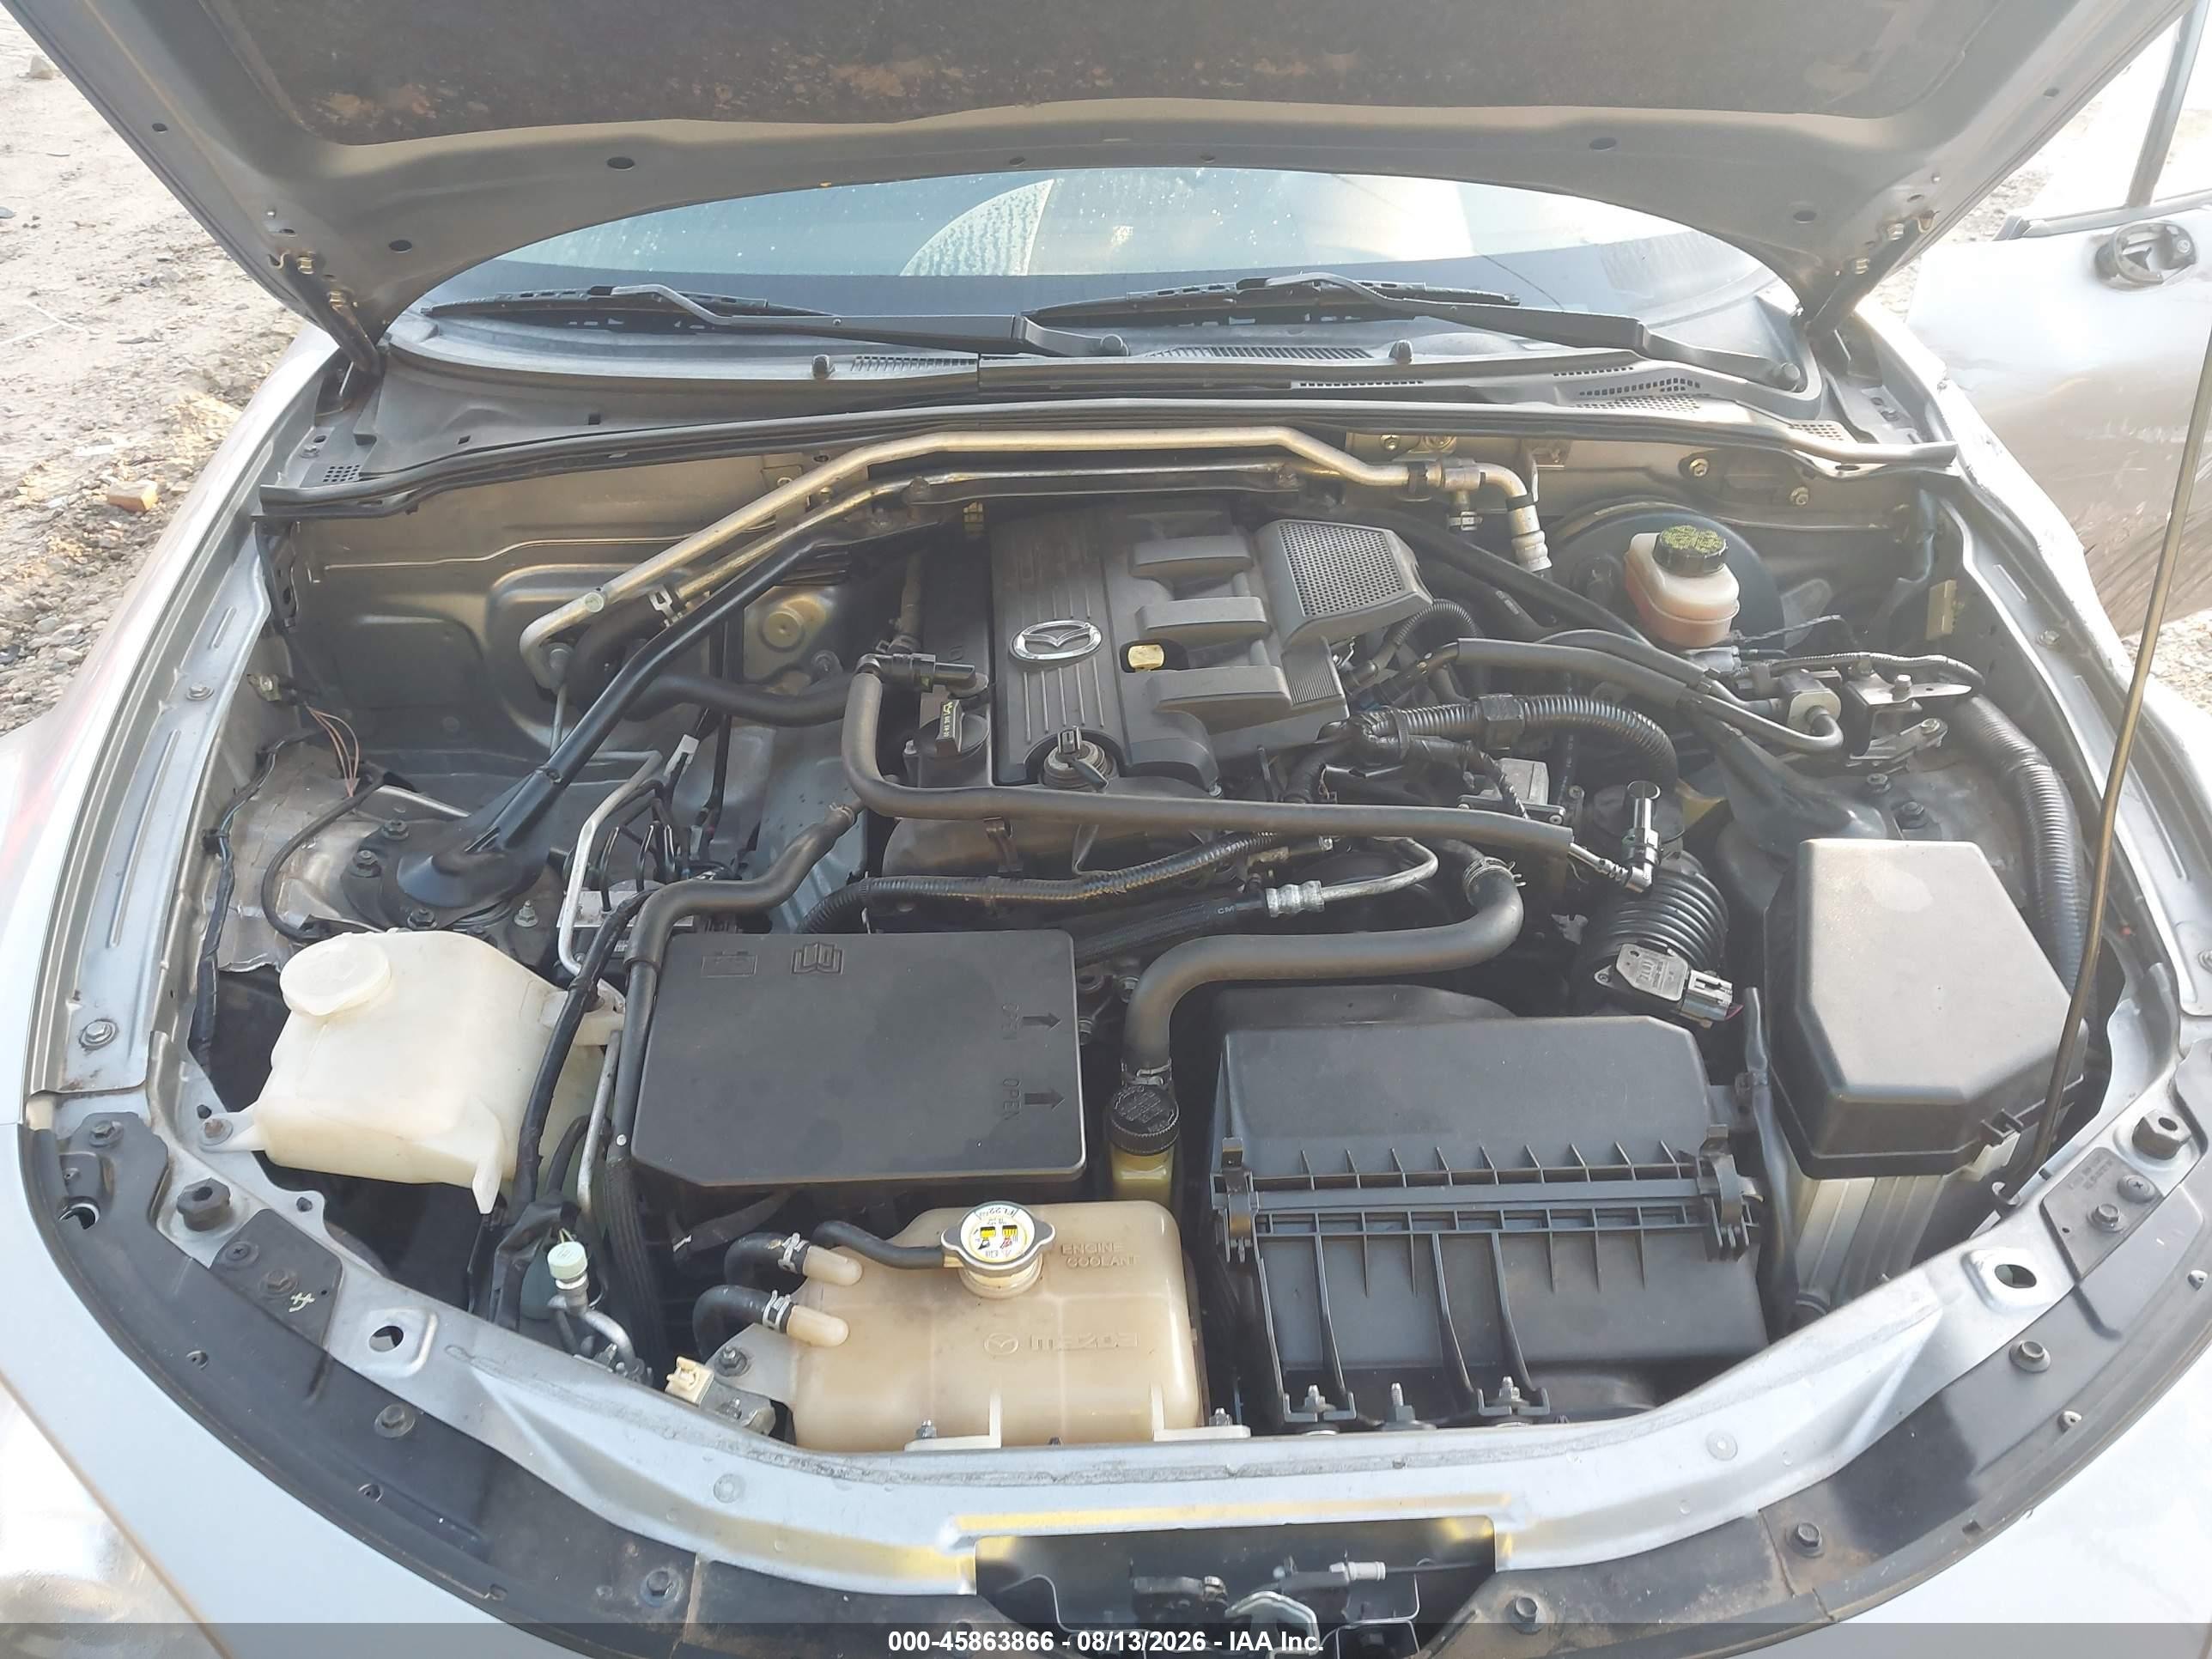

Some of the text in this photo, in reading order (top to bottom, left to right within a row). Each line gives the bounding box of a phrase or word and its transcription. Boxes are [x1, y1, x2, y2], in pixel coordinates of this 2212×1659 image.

[1002, 1078, 1021, 1121] OPEN
[1060, 1242, 1125, 1256] ENGINE
[1065, 1255, 1140, 1269] COOLANT
